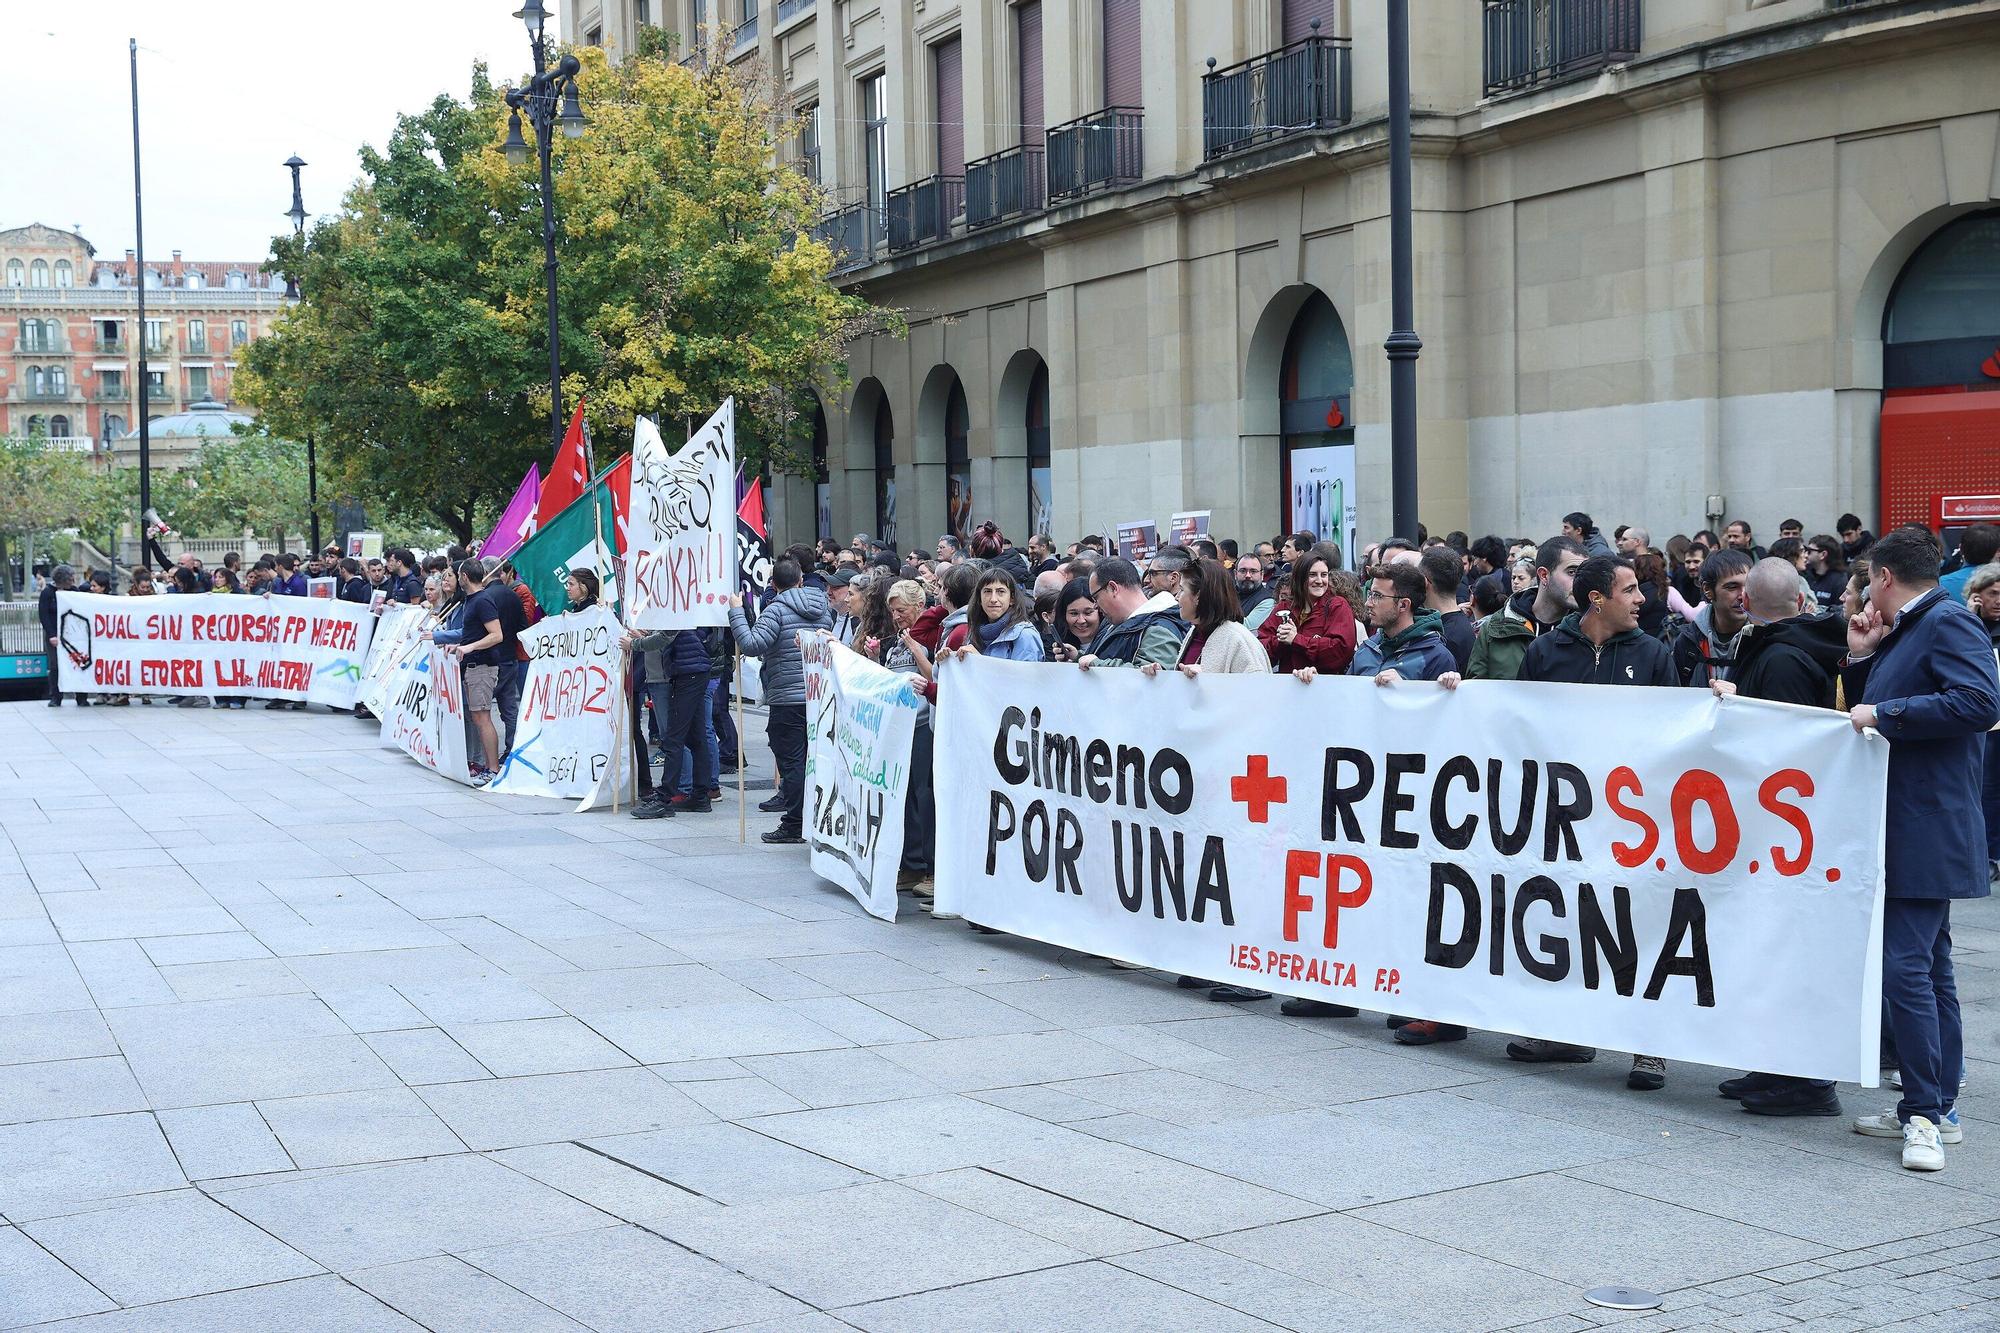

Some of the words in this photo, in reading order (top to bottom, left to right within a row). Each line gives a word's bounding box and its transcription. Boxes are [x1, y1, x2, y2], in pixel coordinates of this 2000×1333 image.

[95, 614, 140, 639] DUAL
[146, 614, 182, 640] SIN
[192, 614, 280, 643] RECURSOS
[283, 616, 306, 644] FP
[94, 658, 131, 686] ONGI
[141, 659, 202, 687] ETORRI
[993, 705, 1194, 815] Gimeno
[1321, 746, 1842, 883] RECURS.O.S.
[984, 789, 1083, 896] POR
[1111, 819, 1235, 926] UNA
[1283, 849, 1373, 949] FP
[1424, 861, 1716, 1008] DIGNA
[1266, 950, 1357, 988] PERALTA
[1374, 968, 1401, 995] F.P.
